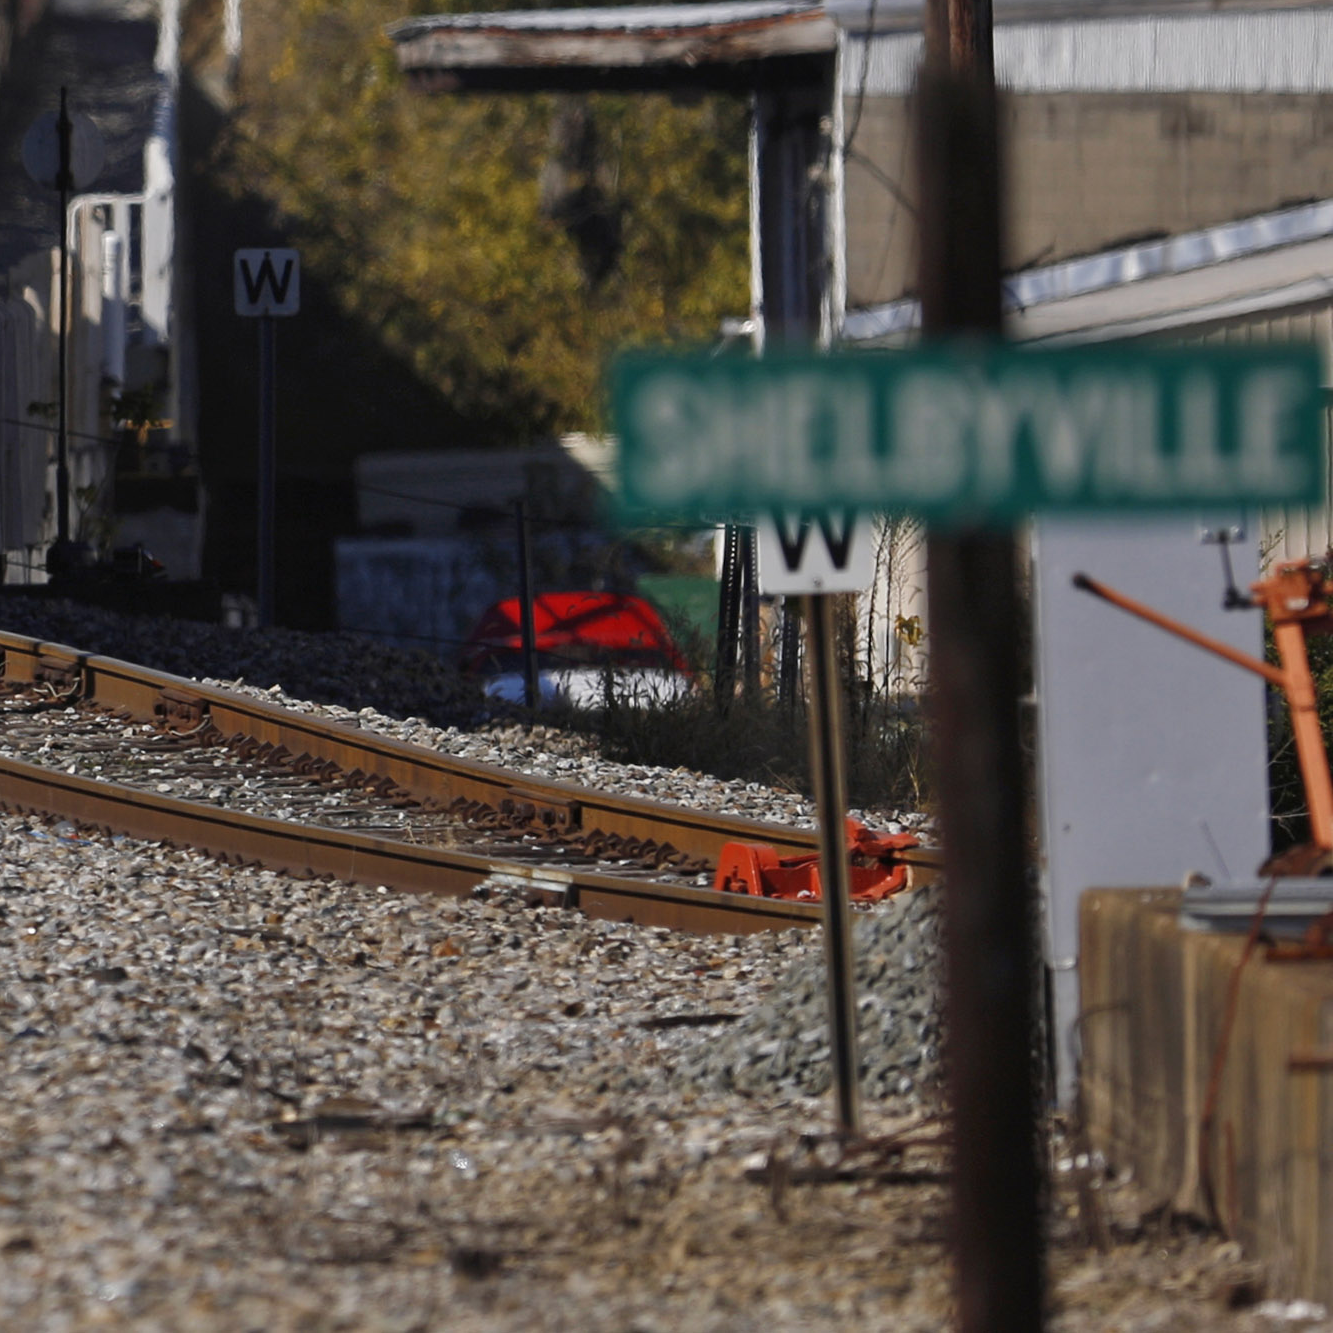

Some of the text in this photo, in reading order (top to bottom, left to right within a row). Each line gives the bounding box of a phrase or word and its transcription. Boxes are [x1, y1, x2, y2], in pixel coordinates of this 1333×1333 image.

[239, 258, 294, 305] W
[637, 369, 1309, 501] SHELBYVILLE
[768, 502, 859, 573] W
